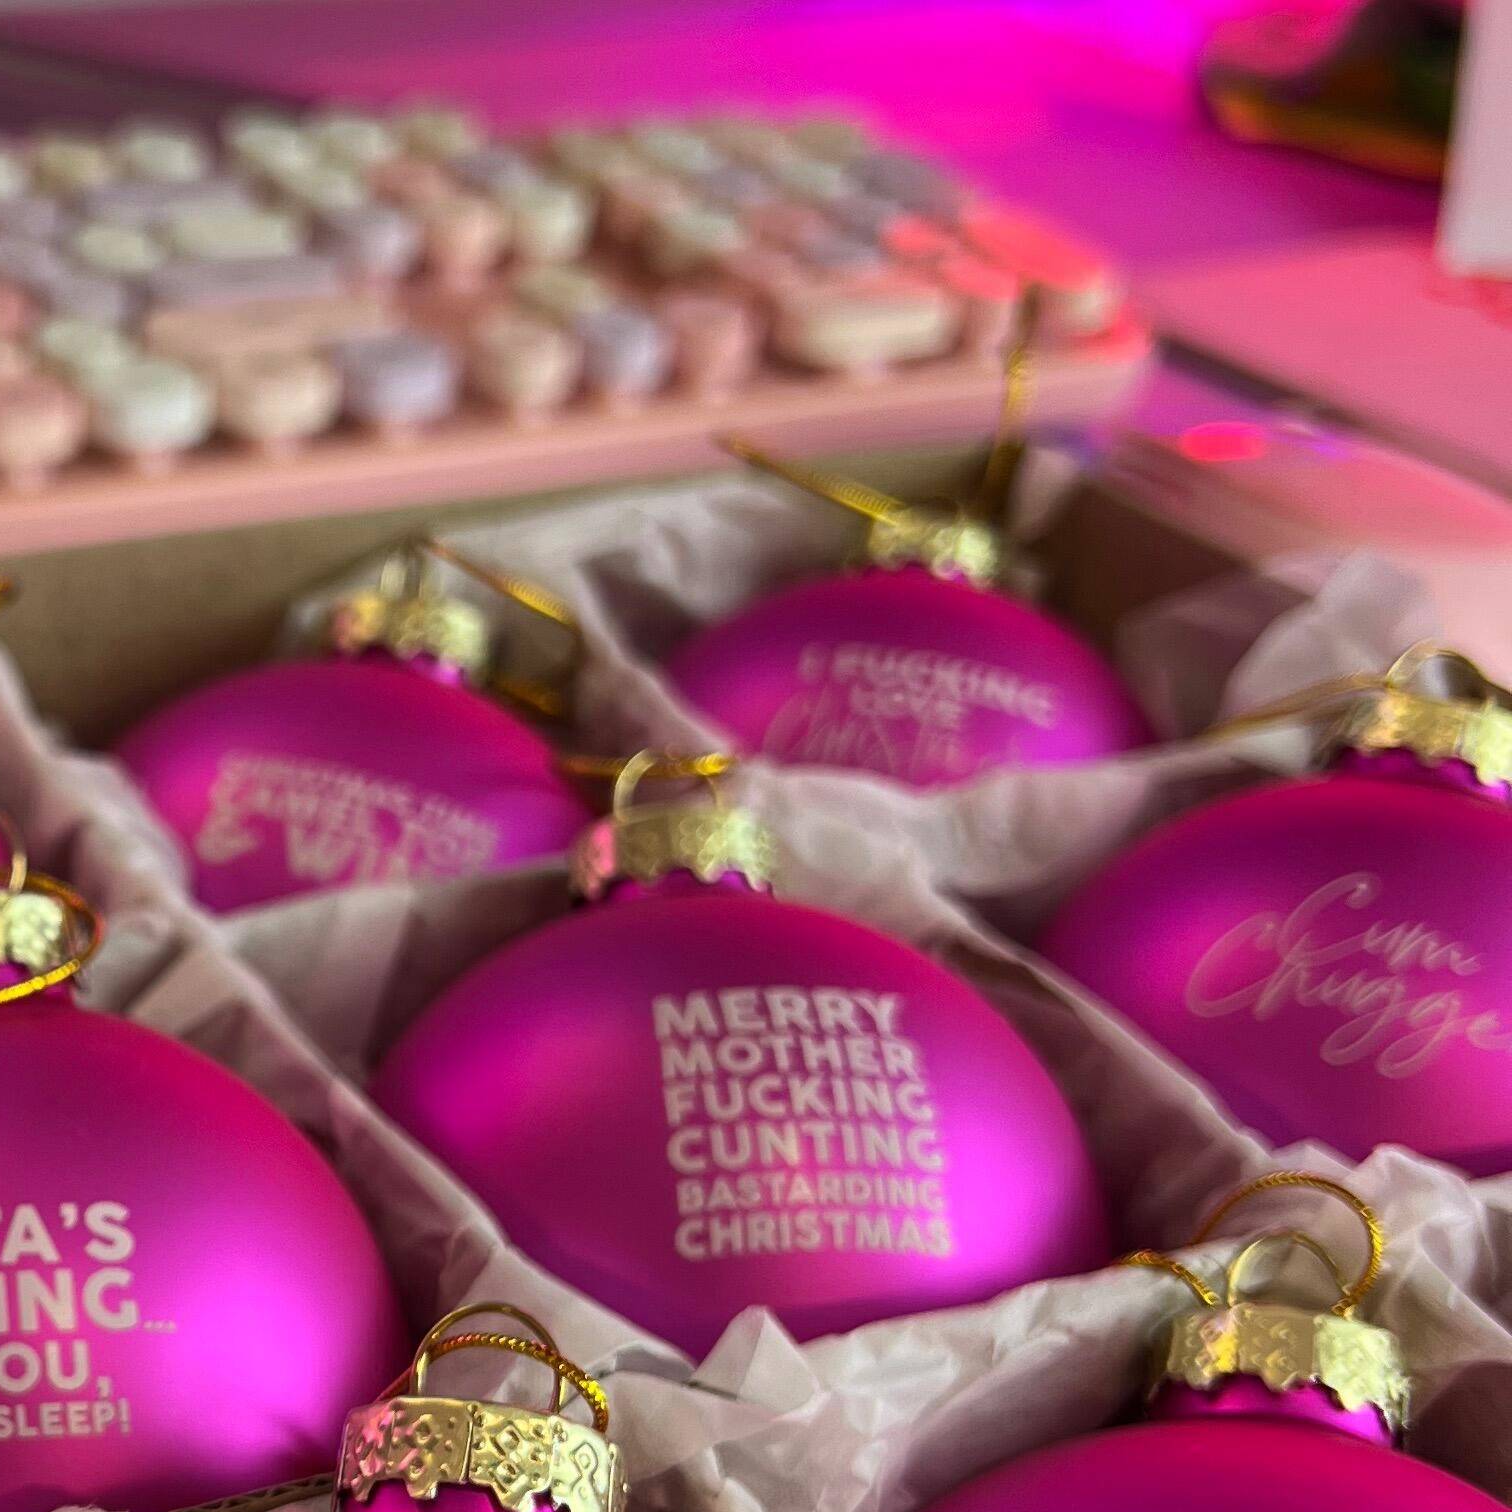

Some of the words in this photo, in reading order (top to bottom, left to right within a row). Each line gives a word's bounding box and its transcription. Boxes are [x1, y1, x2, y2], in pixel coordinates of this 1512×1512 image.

[652, 986, 901, 1038] MERRY
[1185, 910, 1512, 1080] Chugge
[661, 1035, 920, 1081] MOTHER
[663, 1073, 935, 1127] FUCKING
[666, 1121, 945, 1175] CUNTING
[676, 1171, 945, 1216] BASTARDING
[673, 1209, 954, 1262] CHRISTMAS
